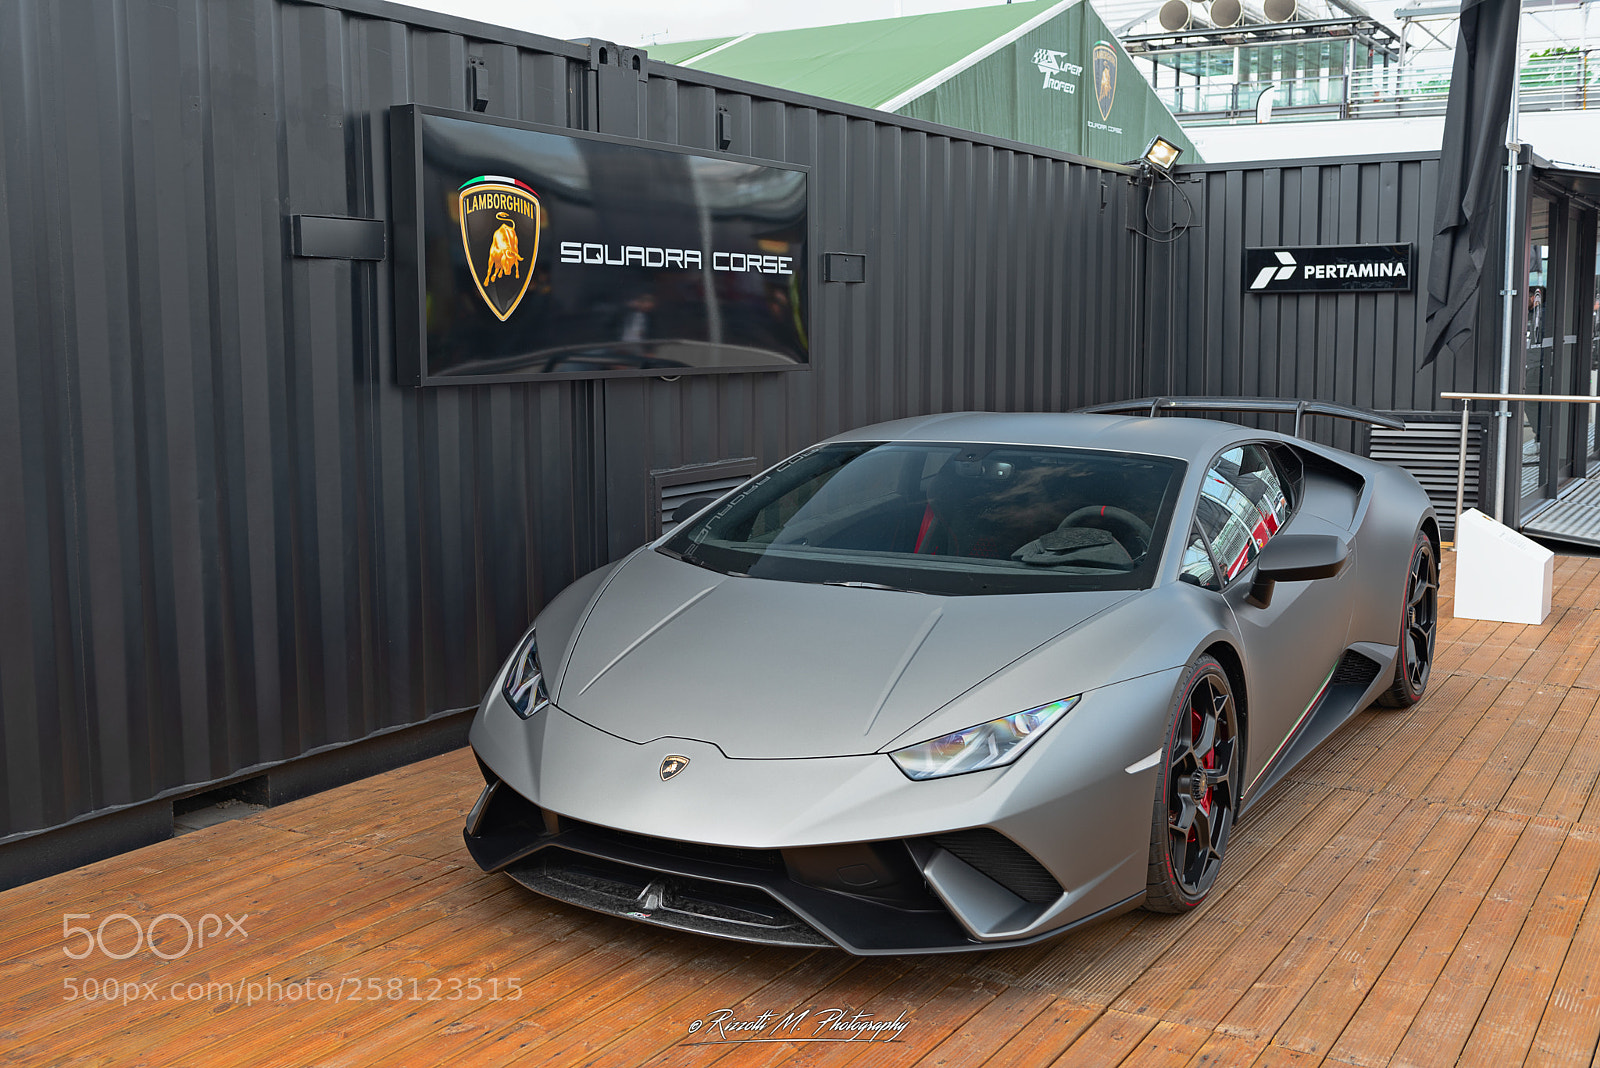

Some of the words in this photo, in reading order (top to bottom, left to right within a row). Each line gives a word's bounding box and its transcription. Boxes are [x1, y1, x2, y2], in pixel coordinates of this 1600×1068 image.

[1037, 49, 1083, 76] SUPER
[1038, 65, 1075, 94] TROFEO
[466, 193, 534, 219] LAMBORGHINI
[560, 241, 702, 270] SQUADRA
[713, 251, 793, 275] CORSE
[1304, 262, 1406, 279] PERTAMINA
